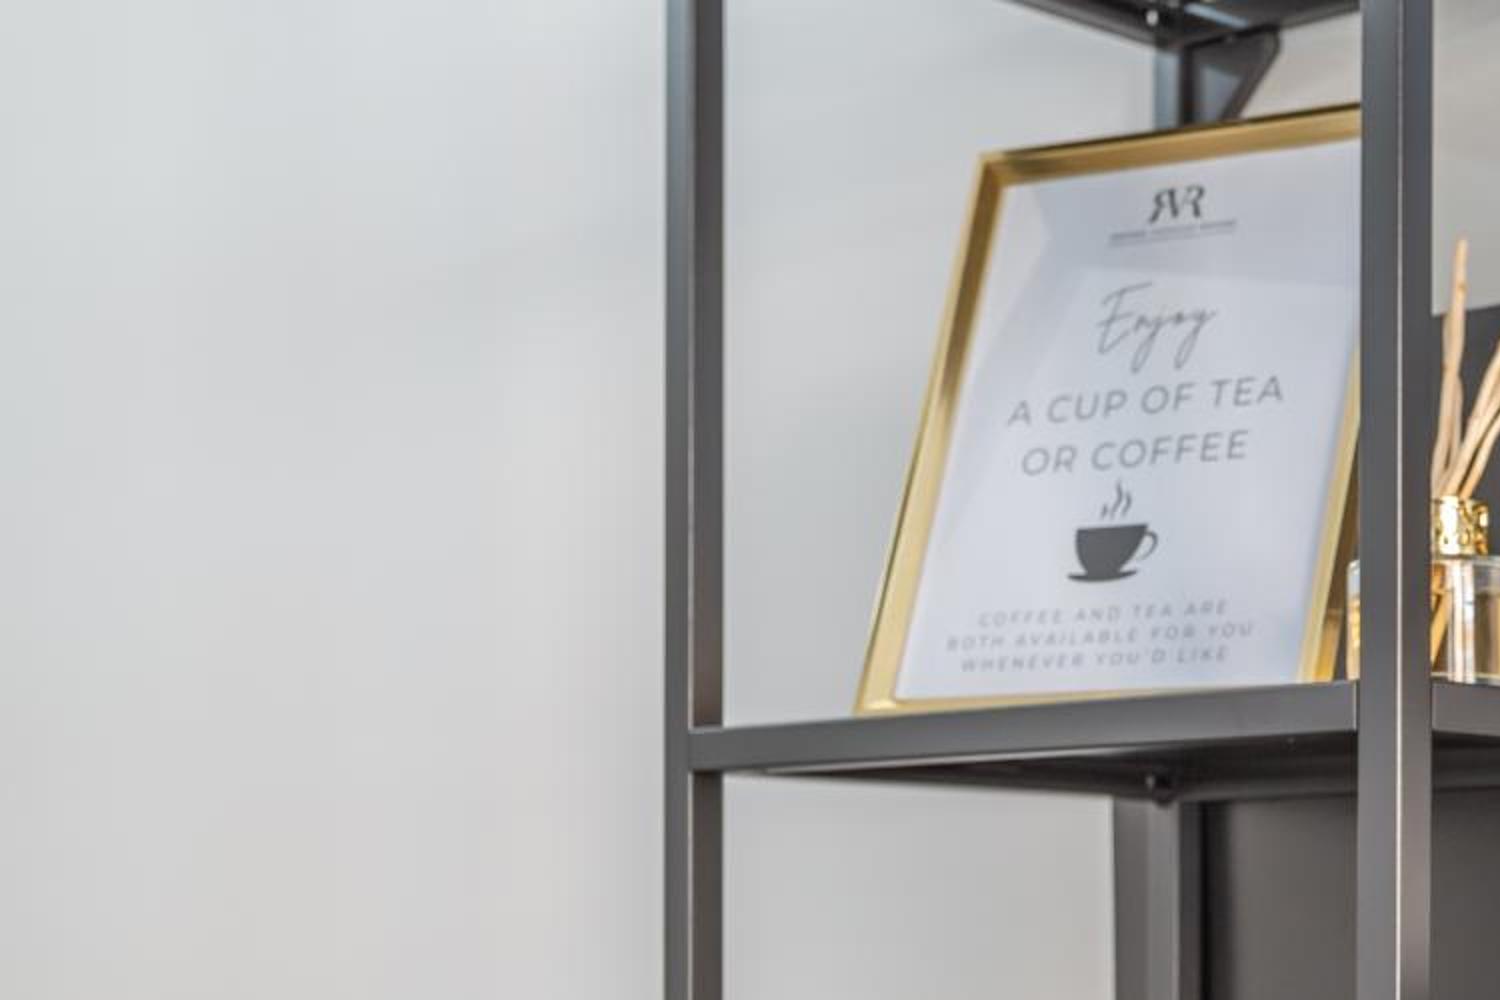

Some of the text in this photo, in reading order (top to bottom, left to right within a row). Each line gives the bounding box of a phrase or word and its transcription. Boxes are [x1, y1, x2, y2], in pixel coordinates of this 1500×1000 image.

[1097, 281, 1219, 374] Enjoy
[1007, 375, 1284, 426] A CUP OF TEA
[1021, 429, 1249, 476] OR COFFEE
[978, 599, 1228, 628] COFFEE AND TEA ARE
[946, 620, 1253, 653] BOTH AVAILABLE FOR YOU
[960, 653, 1085, 673] WHENEVER
[1176, 644, 1228, 663] LIKE
